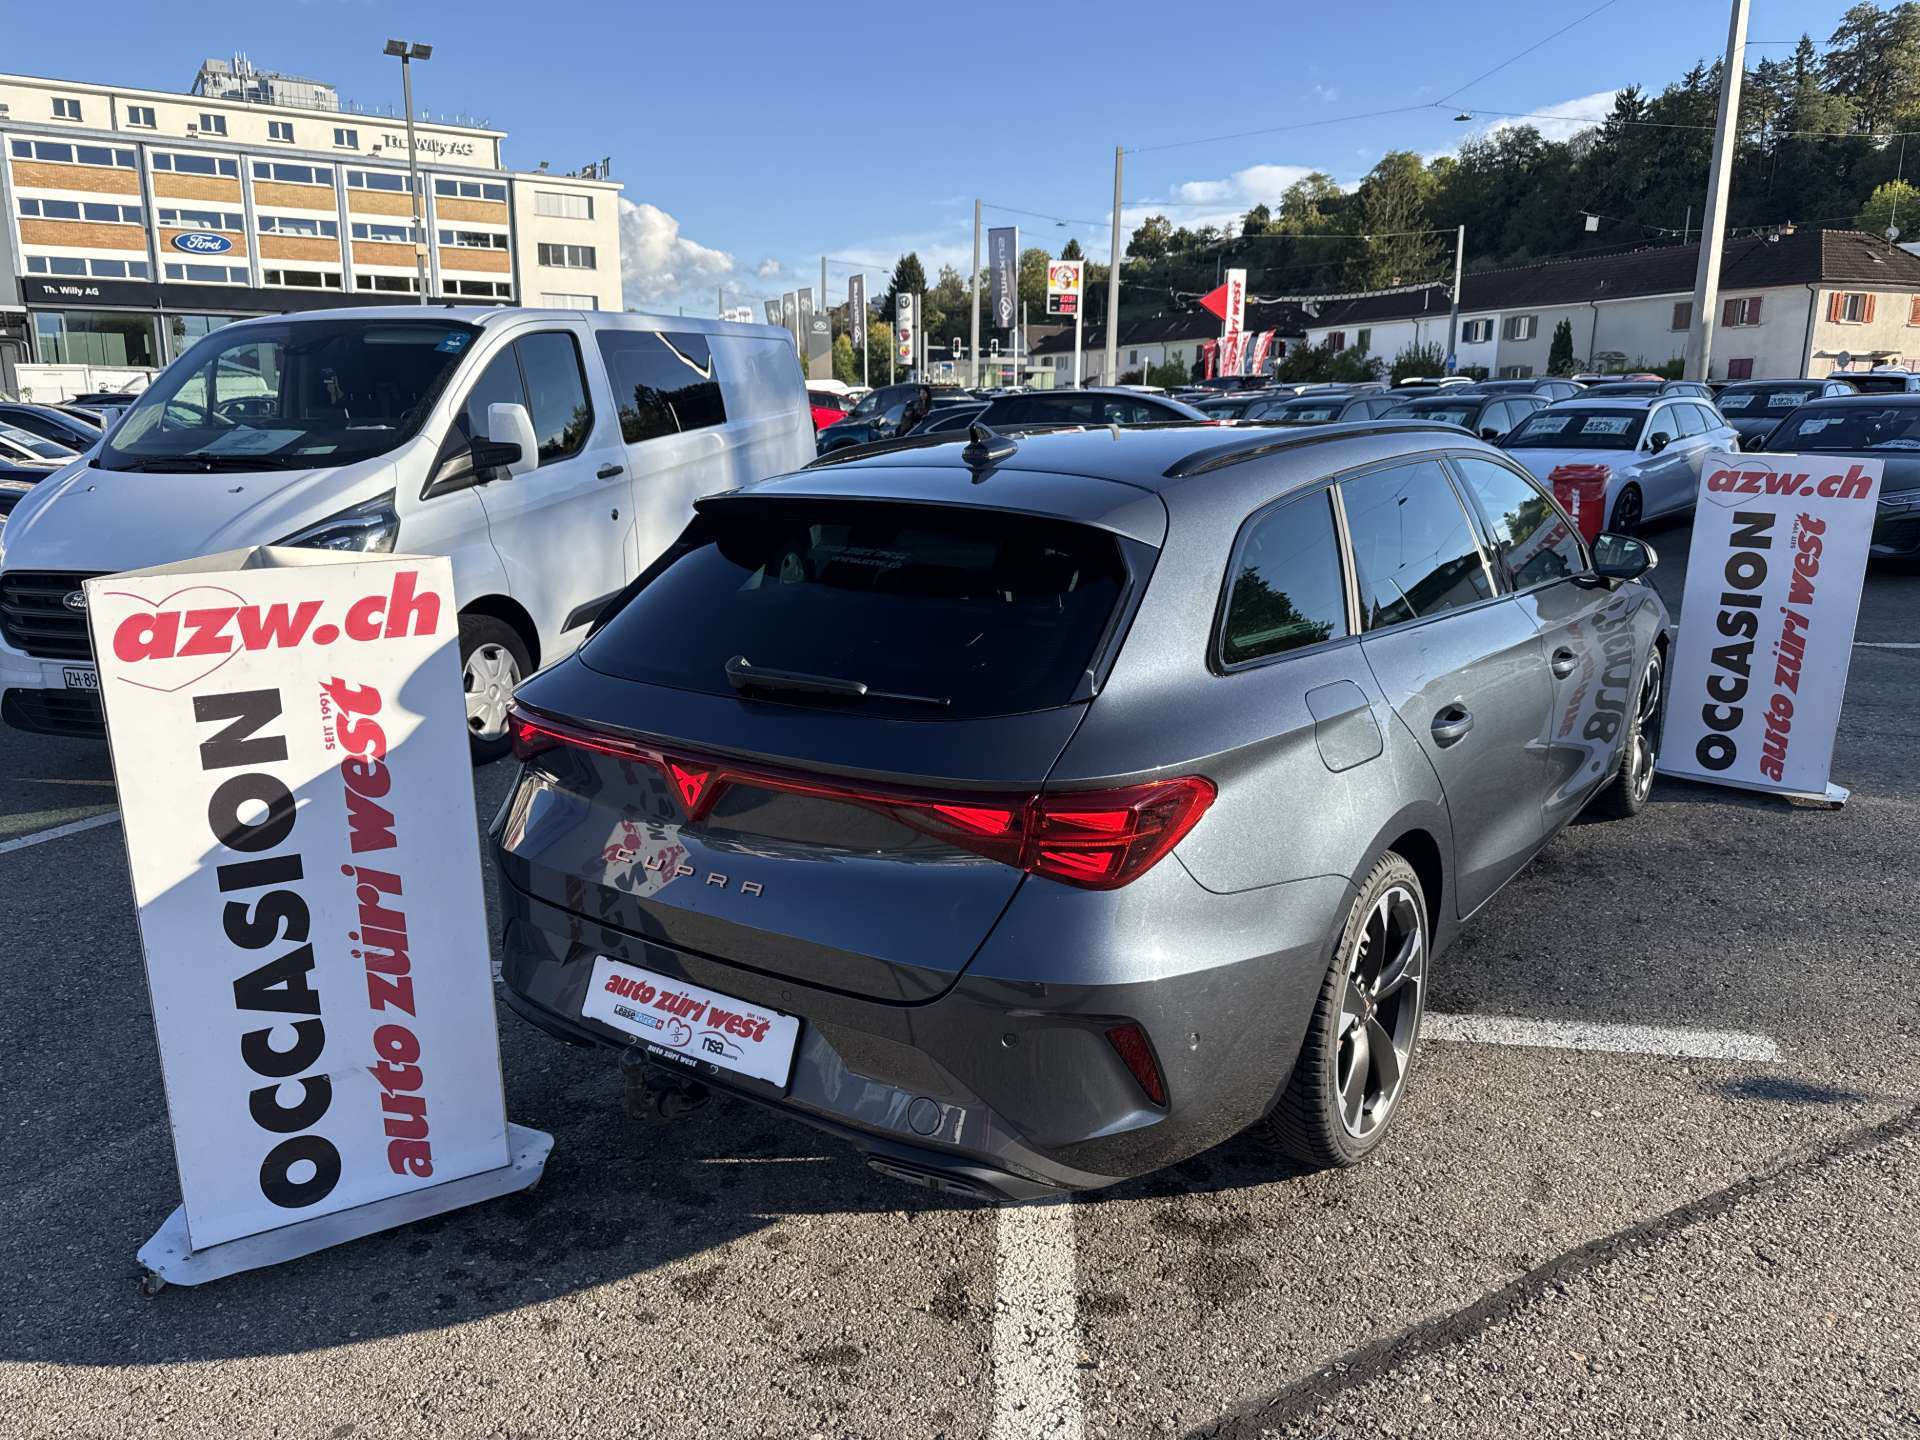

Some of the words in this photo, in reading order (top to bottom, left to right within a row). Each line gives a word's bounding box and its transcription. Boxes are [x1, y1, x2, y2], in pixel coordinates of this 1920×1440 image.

[186, 235, 222, 251] Ford
[43, 285, 58, 294] Th.
[58, 286, 83, 296] Willy
[85, 287, 99, 296] AG
[1707, 465, 1873, 499] azw.ch
[1788, 512, 1827, 605] west
[113, 571, 441, 662] azw.ch
[1695, 511, 1777, 771] OCCASION
[1772, 606, 1811, 697] züri
[319, 692, 332, 721] 1991
[323, 725, 336, 750] SEIT
[1760, 693, 1796, 782] auto
[319, 676, 398, 854] west
[615, 848, 764, 897] CUPRA
[193, 688, 341, 1208] OCCASION
[341, 864, 416, 1018] züri
[604, 974, 656, 1005] auto
[653, 991, 711, 1023] züri
[706, 1006, 771, 1043] west
[702, 1036, 724, 1055] nsa
[647, 1044, 664, 1055] auto
[680, 1055, 698, 1067] west
[366, 1024, 434, 1178] auto
